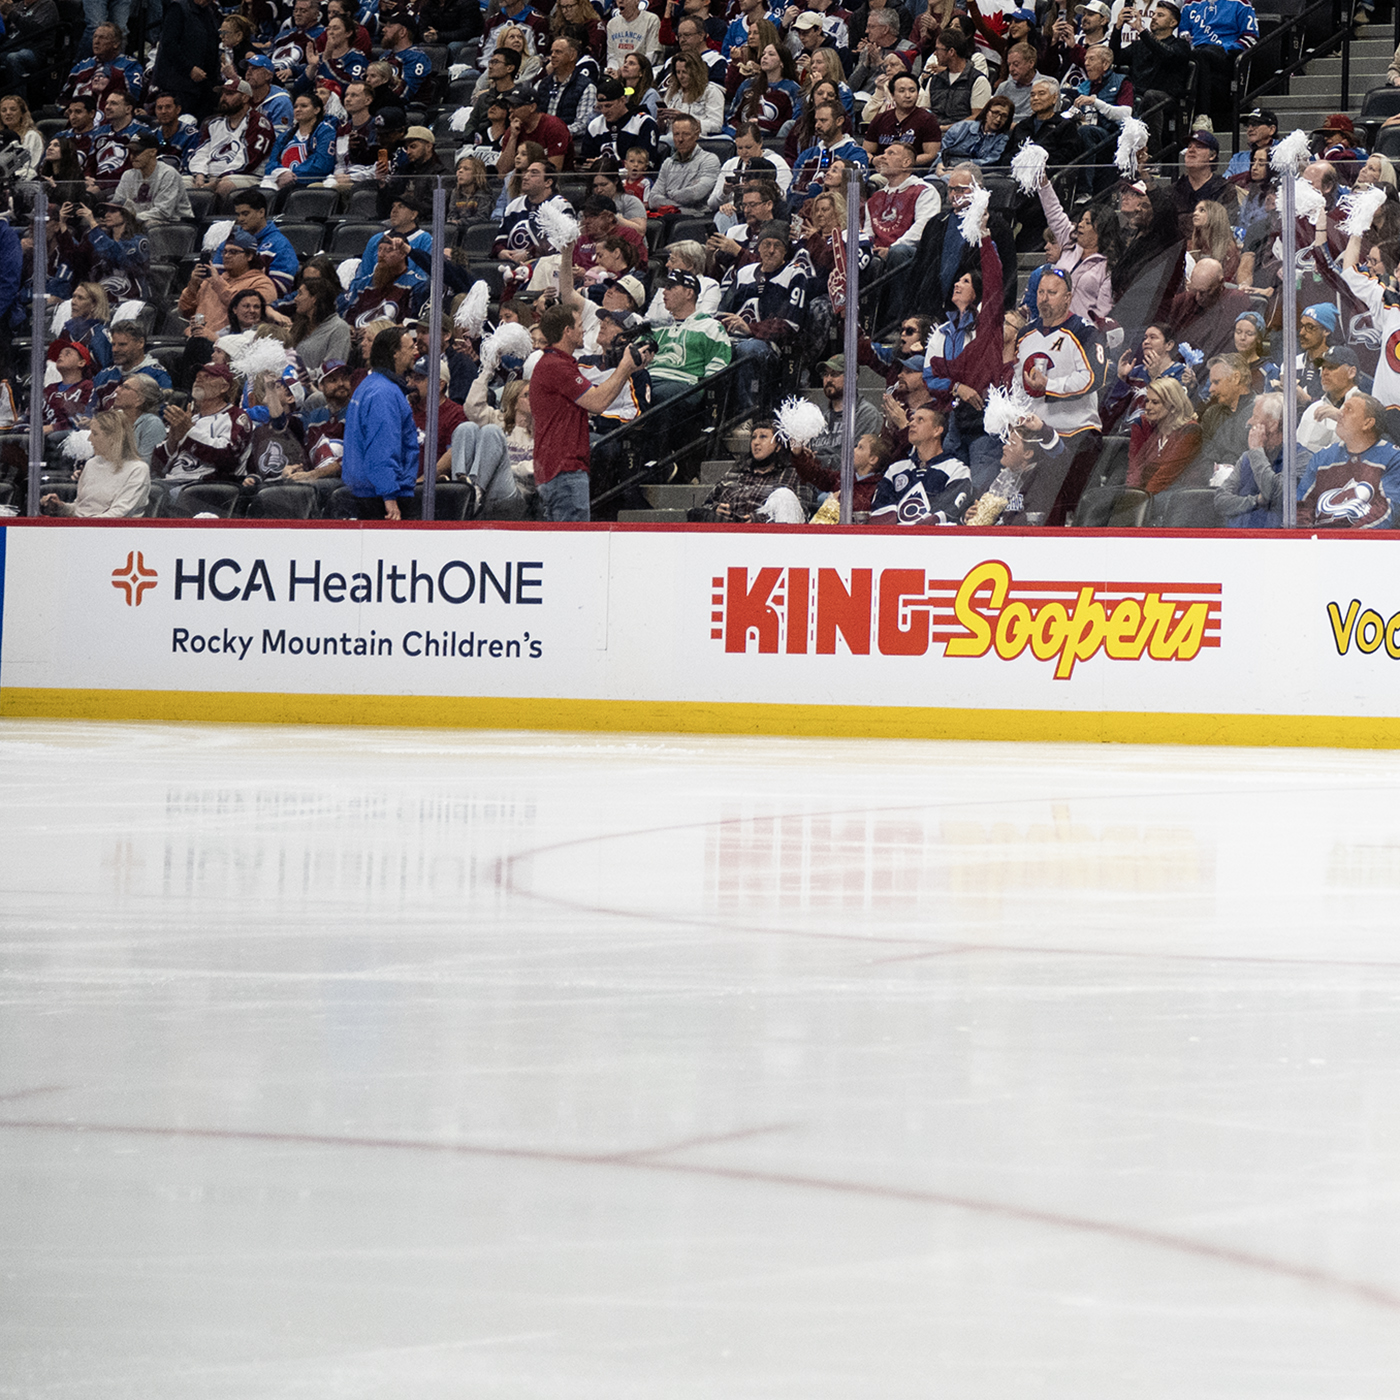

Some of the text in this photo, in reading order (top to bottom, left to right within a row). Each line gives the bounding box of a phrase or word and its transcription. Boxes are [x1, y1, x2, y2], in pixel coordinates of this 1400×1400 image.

[414, 62, 424, 75] 8
[791, 288, 804, 308] 91
[1051, 337, 1063, 351] A
[1096, 343, 1104, 362] 8
[67, 388, 81, 401] A
[174, 557, 543, 604] HCA HealthONE
[726, 558, 1210, 680] KING Soopers
[171, 627, 544, 661] Rocky Mountain Children's
